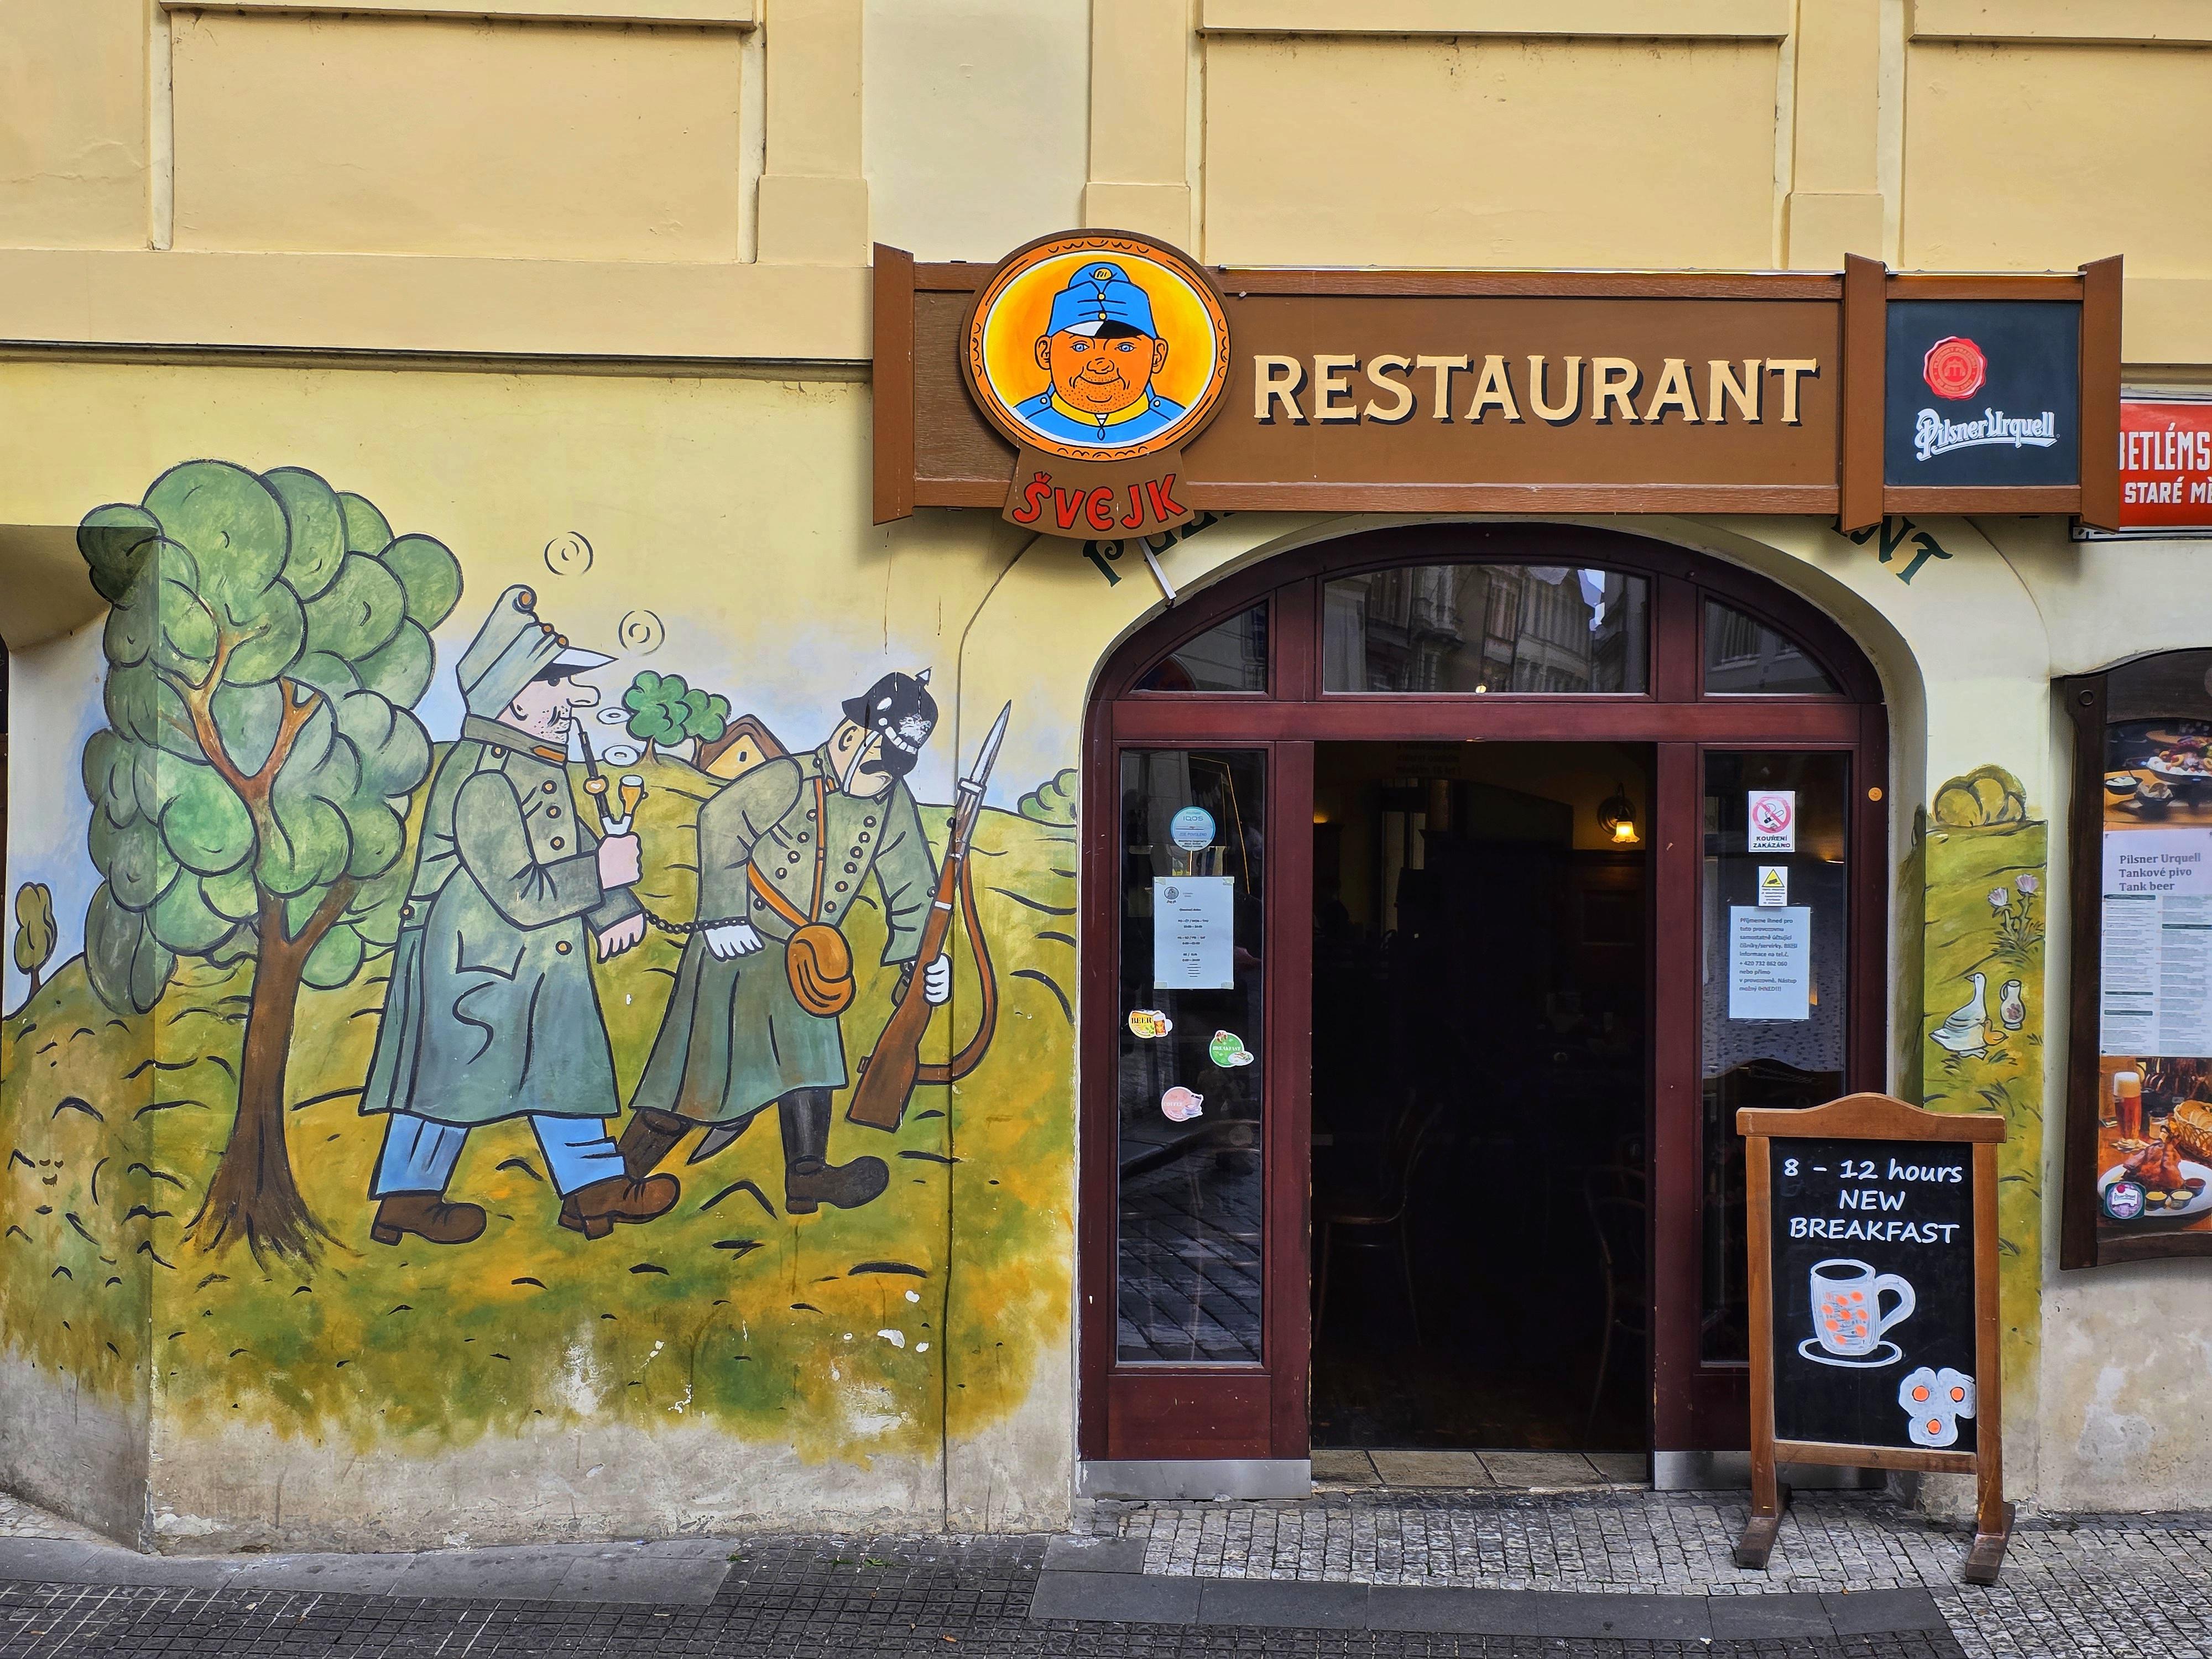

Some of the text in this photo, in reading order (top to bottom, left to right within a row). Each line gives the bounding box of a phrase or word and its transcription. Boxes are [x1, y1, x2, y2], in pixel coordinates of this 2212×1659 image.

[1254, 354, 1819, 426] RESTAURANT
[1914, 408, 2056, 461] Pilsner Urquell
[1012, 471, 1188, 531] ŠVEJK
[2125, 476, 2184, 503] STARÉ
[2120, 852, 2201, 865] Pilsner Urquell
[2119, 867, 2192, 879] Tankové pivo
[2119, 881, 2176, 891] Tank beer
[1784, 1158, 1799, 1176] 8
[1840, 1160, 1878, 1180] 12
[1888, 1158, 1963, 1183] hours
[1839, 1189, 1906, 1211] NEW
[1790, 1217, 1960, 1244] BREAKFAST
